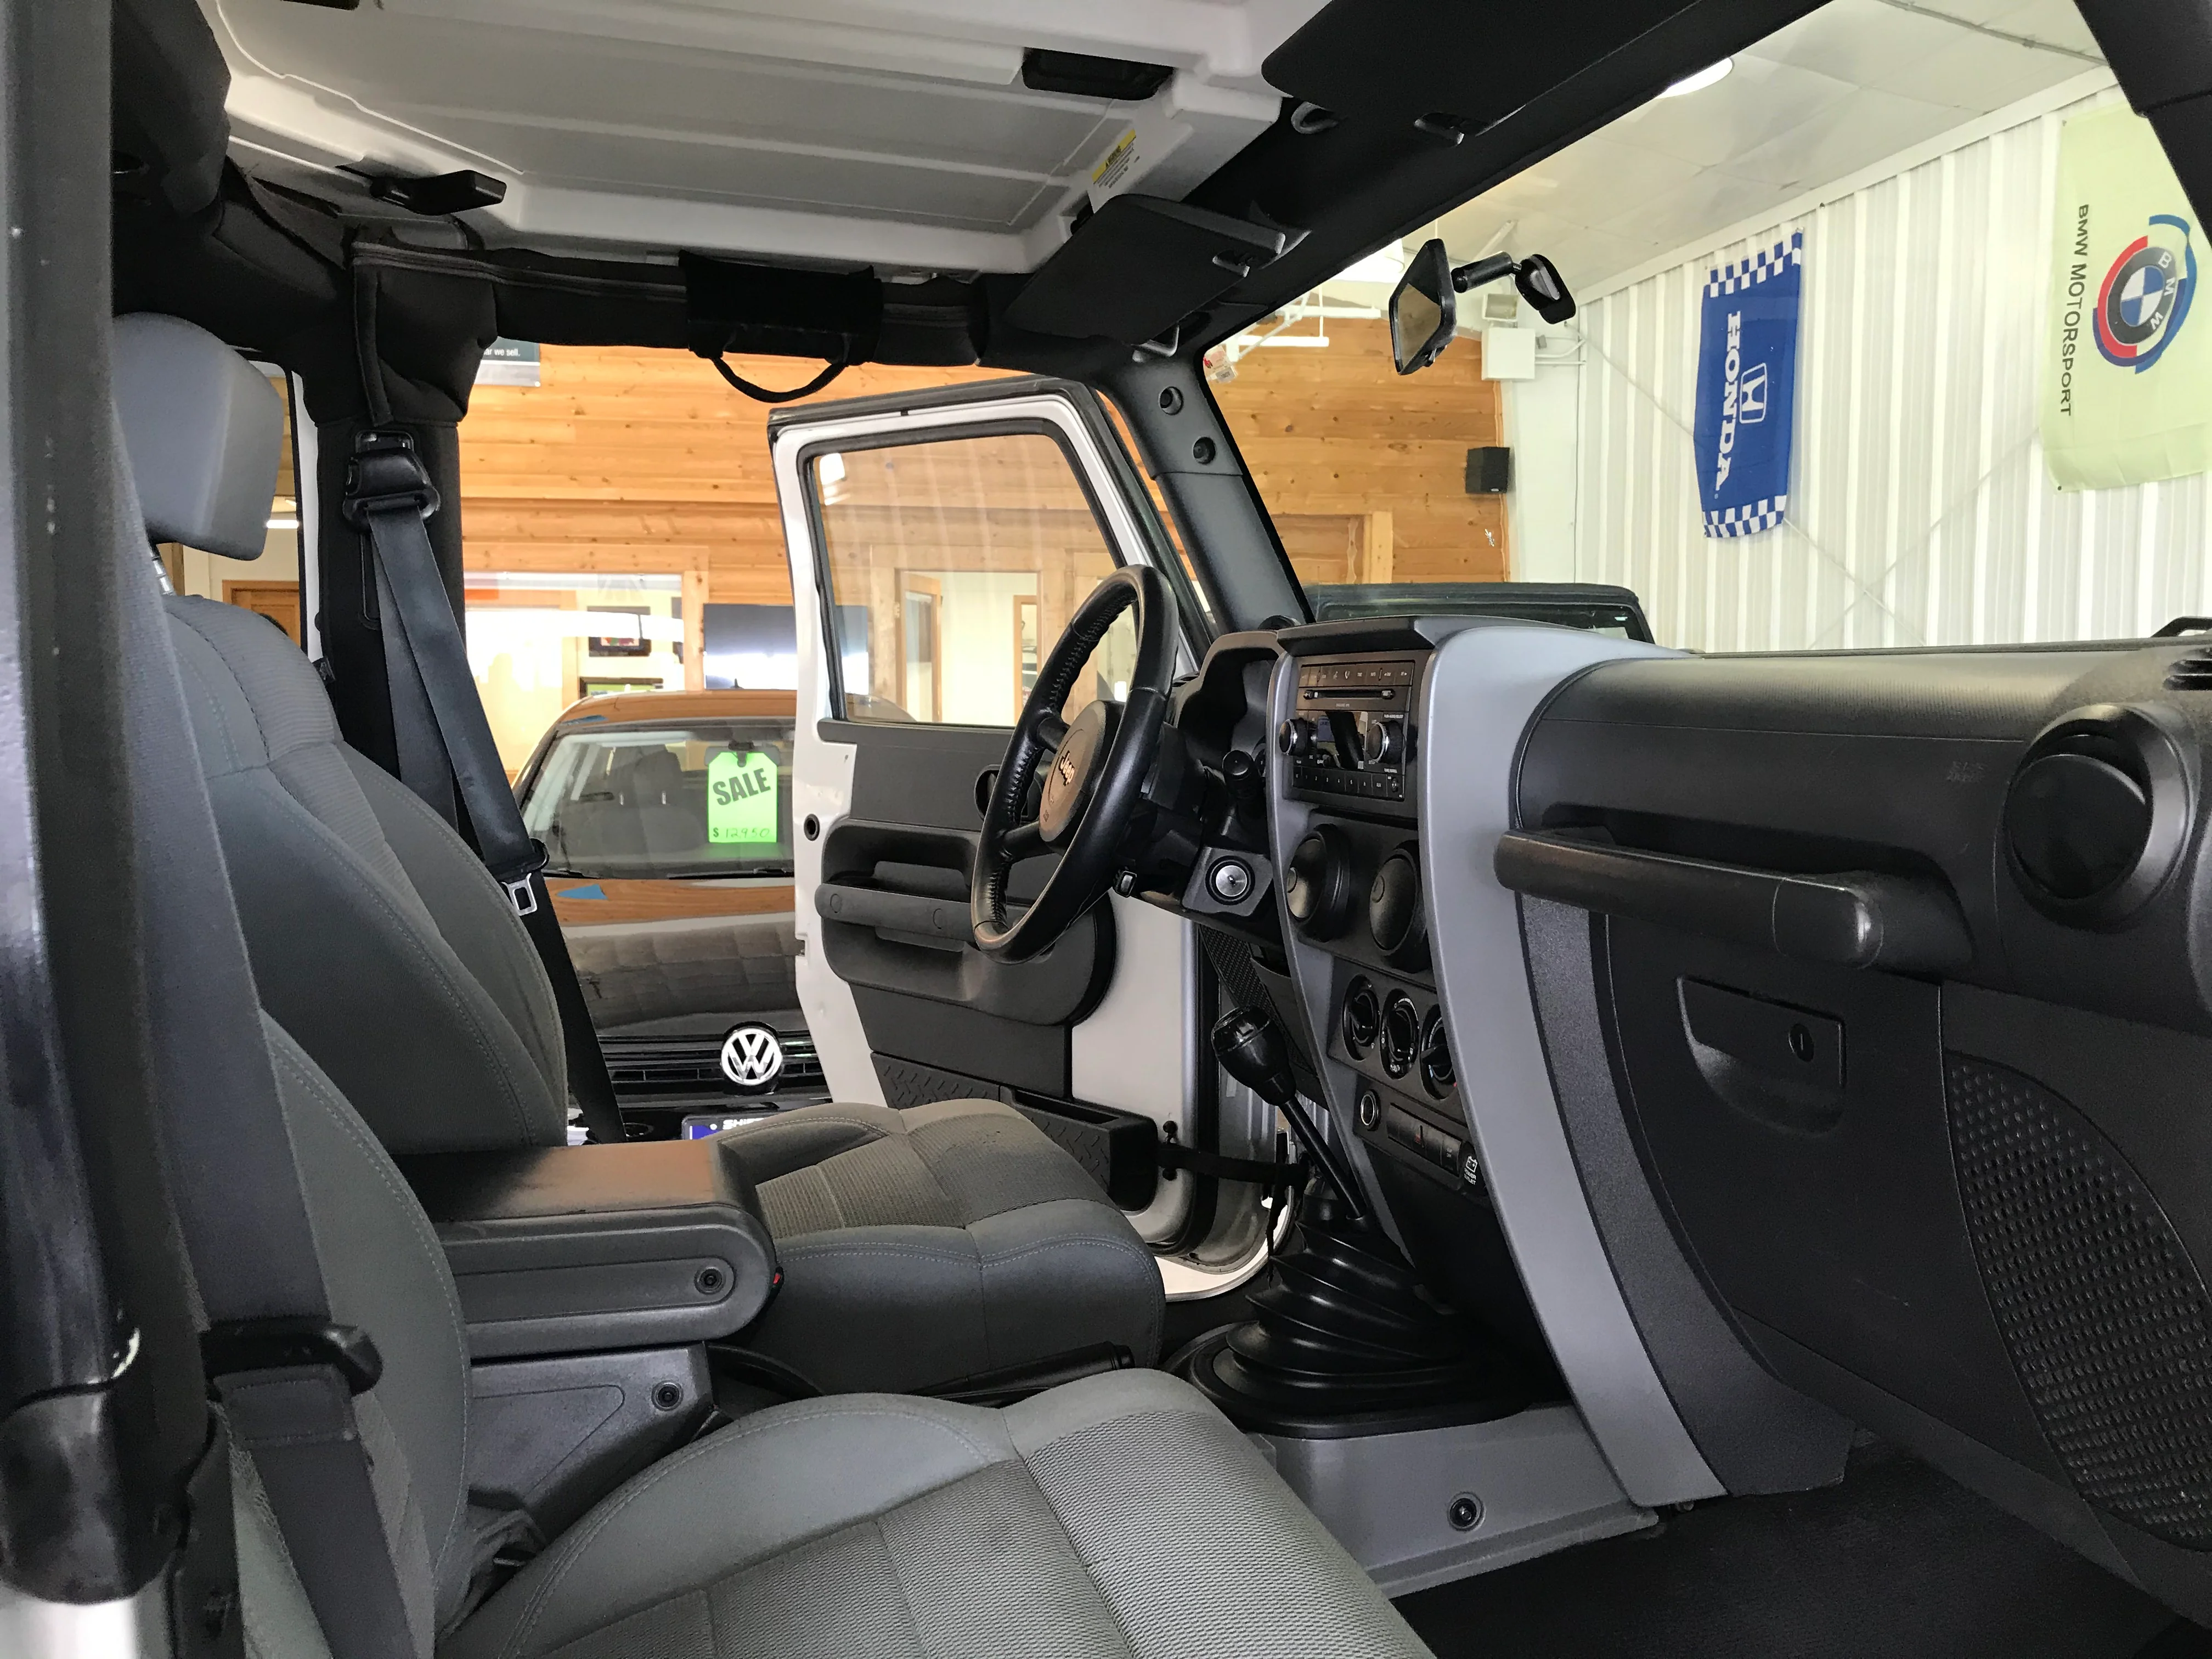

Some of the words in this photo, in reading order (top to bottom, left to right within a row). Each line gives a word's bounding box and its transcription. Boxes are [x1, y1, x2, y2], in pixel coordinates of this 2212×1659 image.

[2074, 204, 2090, 257] BMW
[2060, 263, 2087, 416] MOTORSPORT
[1715, 310, 1741, 491] HONDA
[713, 768, 771, 805] SALE
[1059, 751, 1075, 785] Jeep
